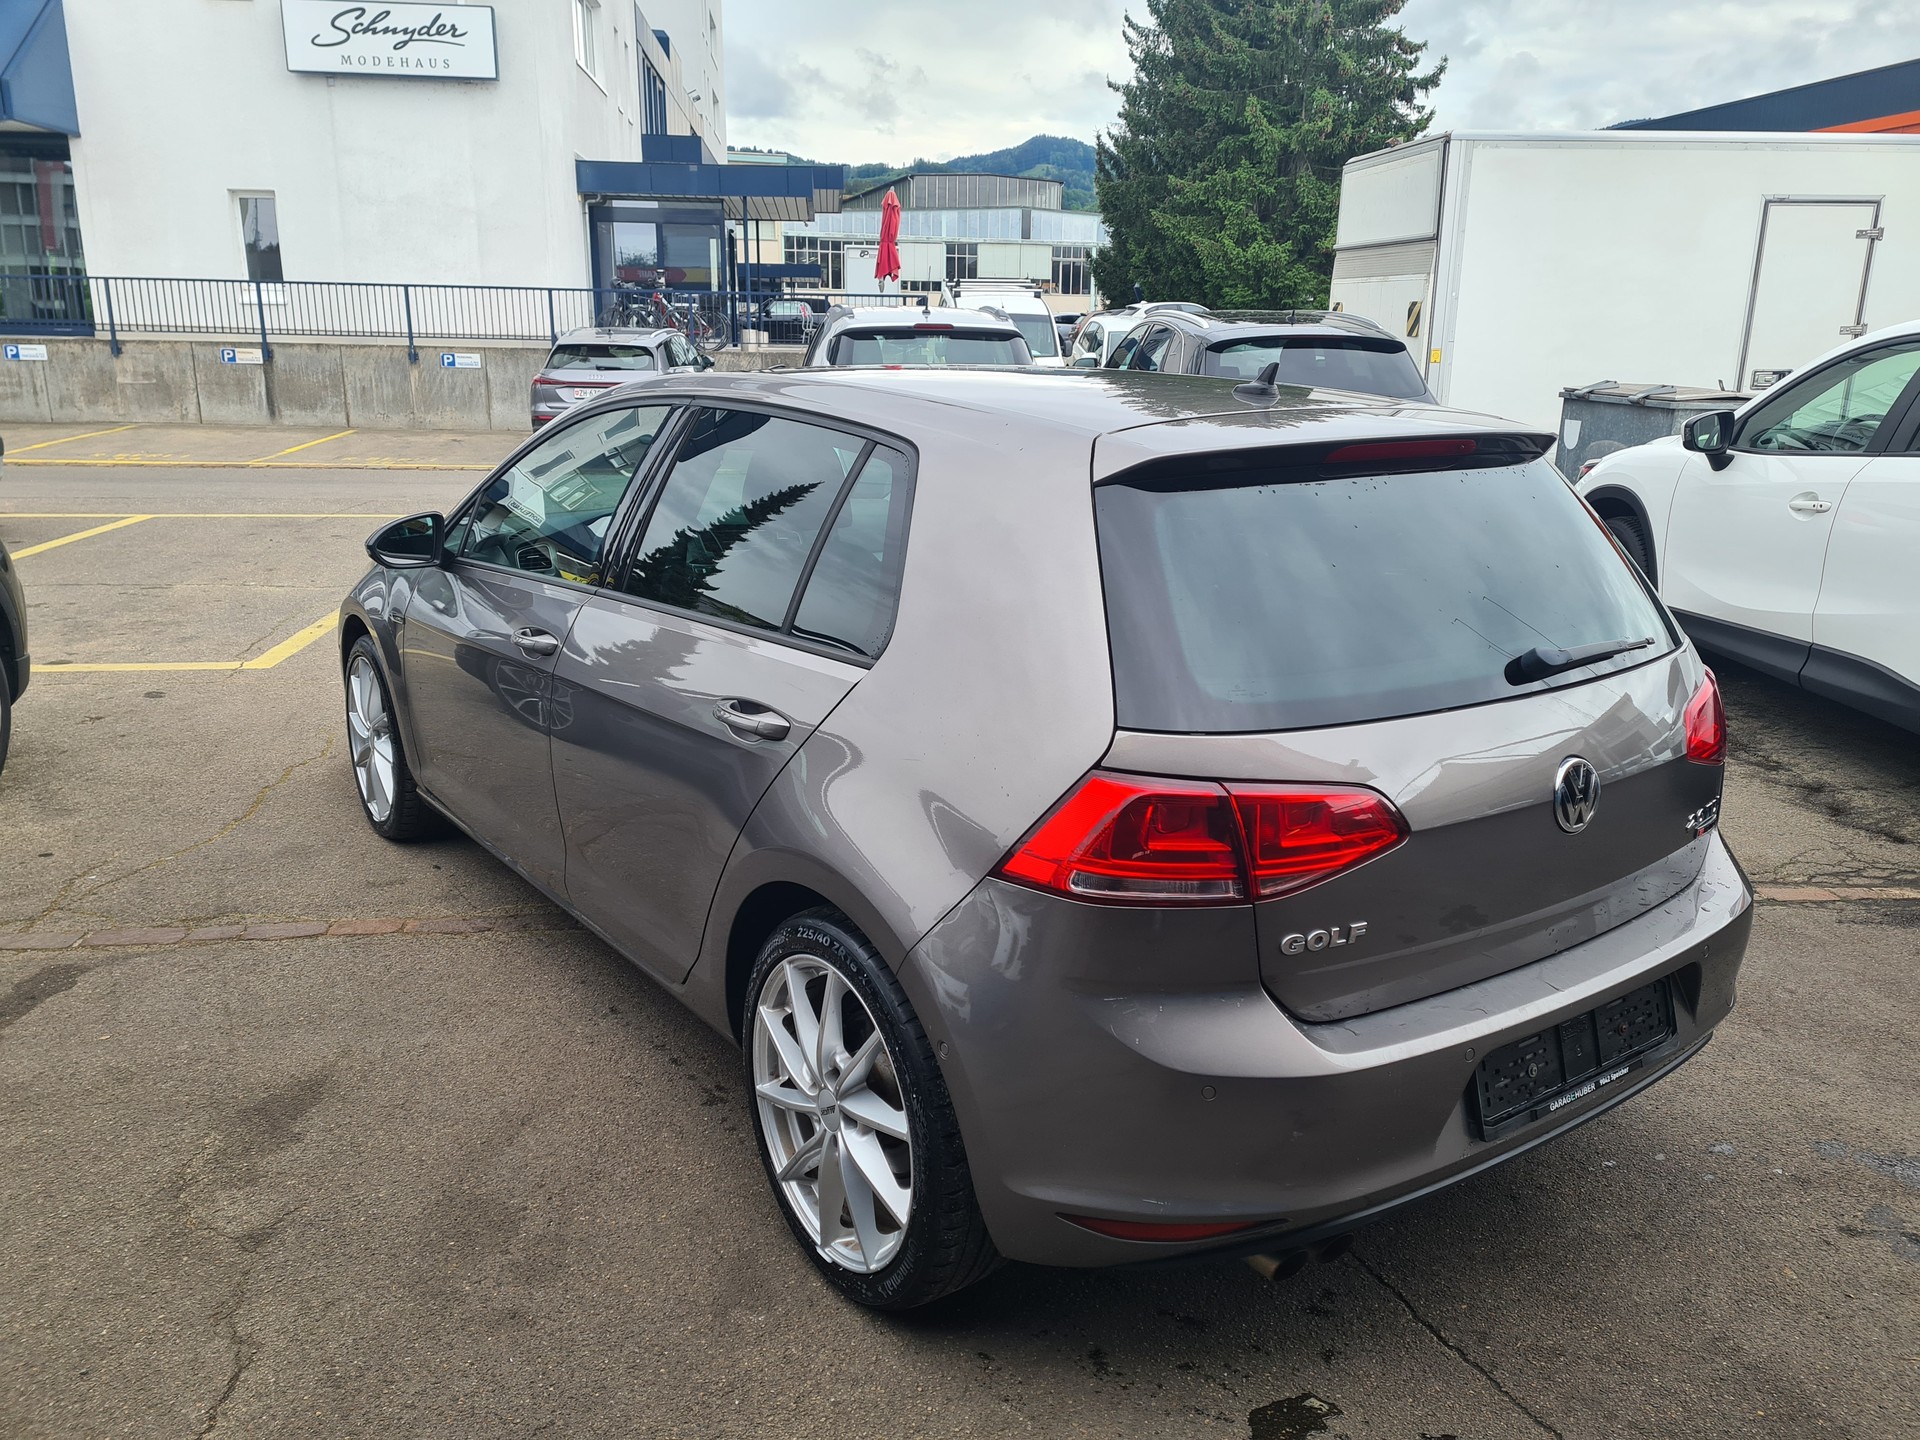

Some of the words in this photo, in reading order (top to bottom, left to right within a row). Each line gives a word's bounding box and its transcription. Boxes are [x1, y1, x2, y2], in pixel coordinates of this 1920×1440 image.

[311, 7, 468, 50] Schnyder
[340, 54, 451, 69] MODEHAUS
[6, 346, 17, 359] P
[223, 350, 234, 362] P
[443, 354, 454, 366] P
[797, 926, 831, 947] 225/40
[1280, 921, 1368, 956] GOLF
